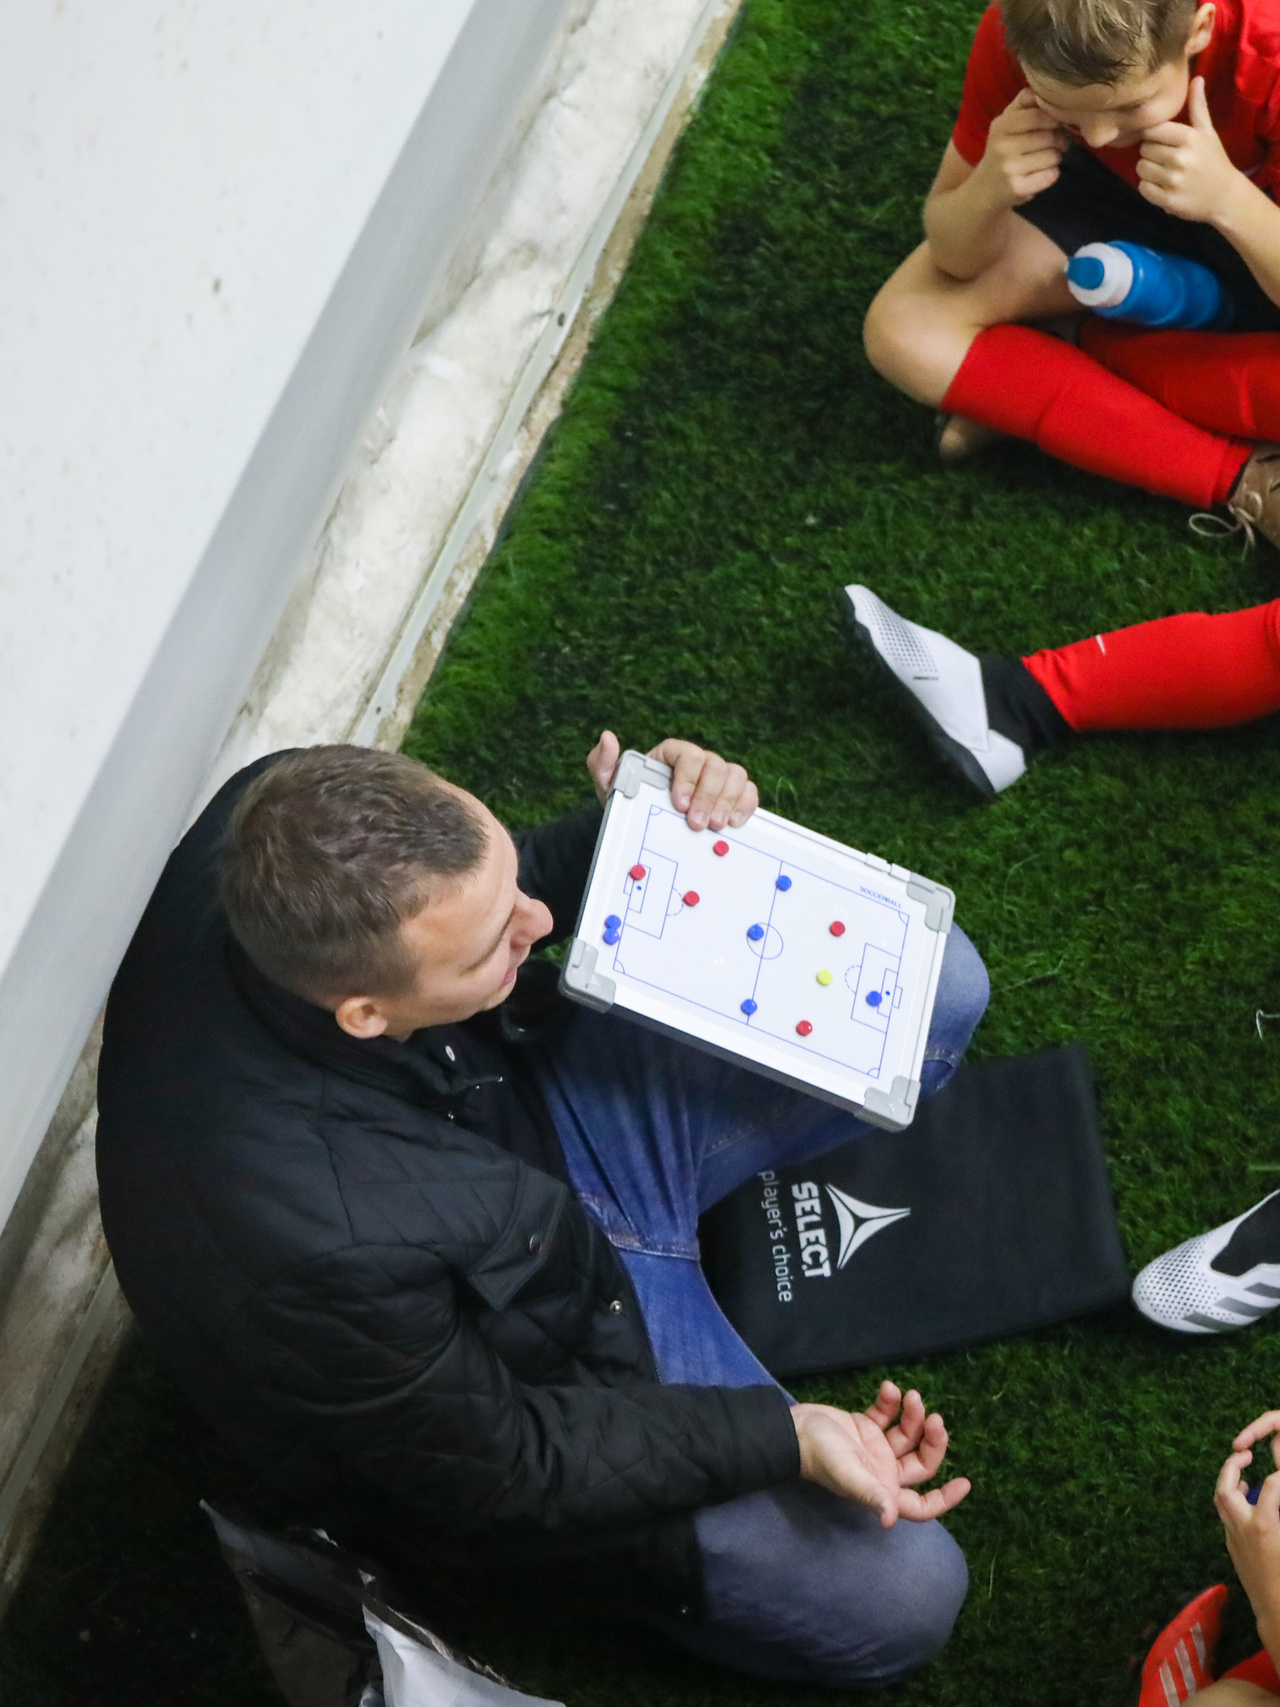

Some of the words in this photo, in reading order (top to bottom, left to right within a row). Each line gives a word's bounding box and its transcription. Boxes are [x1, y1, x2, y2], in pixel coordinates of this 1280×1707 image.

[757, 1170, 788, 1241] player's
[791, 1181, 832, 1278] SELECT
[772, 1244, 795, 1303] choice
